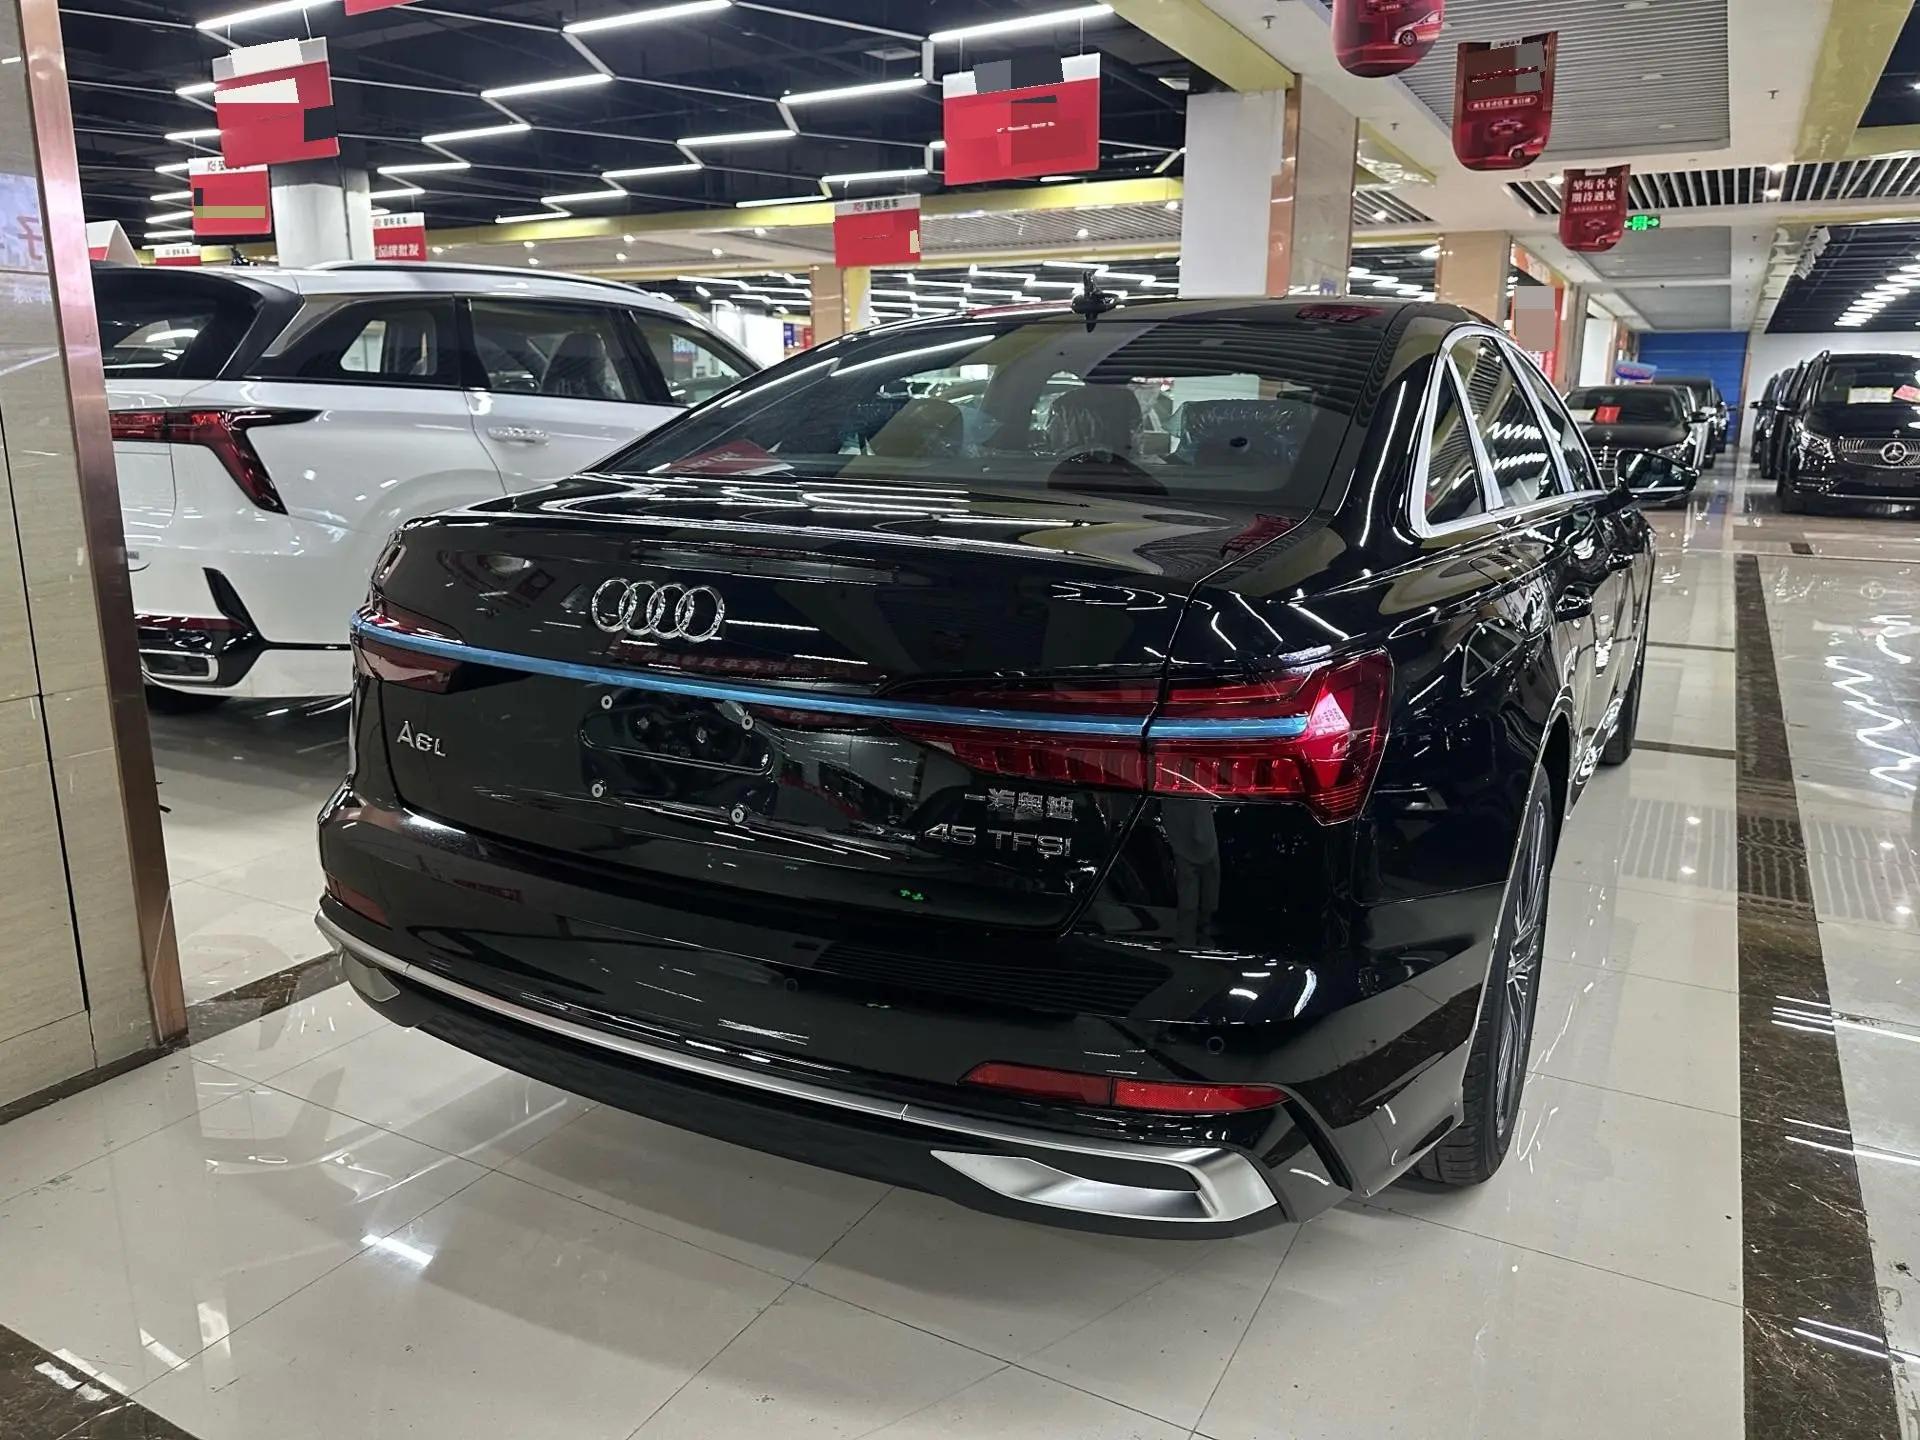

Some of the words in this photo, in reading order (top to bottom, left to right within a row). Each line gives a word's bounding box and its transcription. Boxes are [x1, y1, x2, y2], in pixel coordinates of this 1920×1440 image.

[1571, 190, 1616, 203] 期待遇见
[396, 720, 446, 757] A6L
[924, 823, 977, 846] 45
[987, 828, 1072, 857] TFSI
